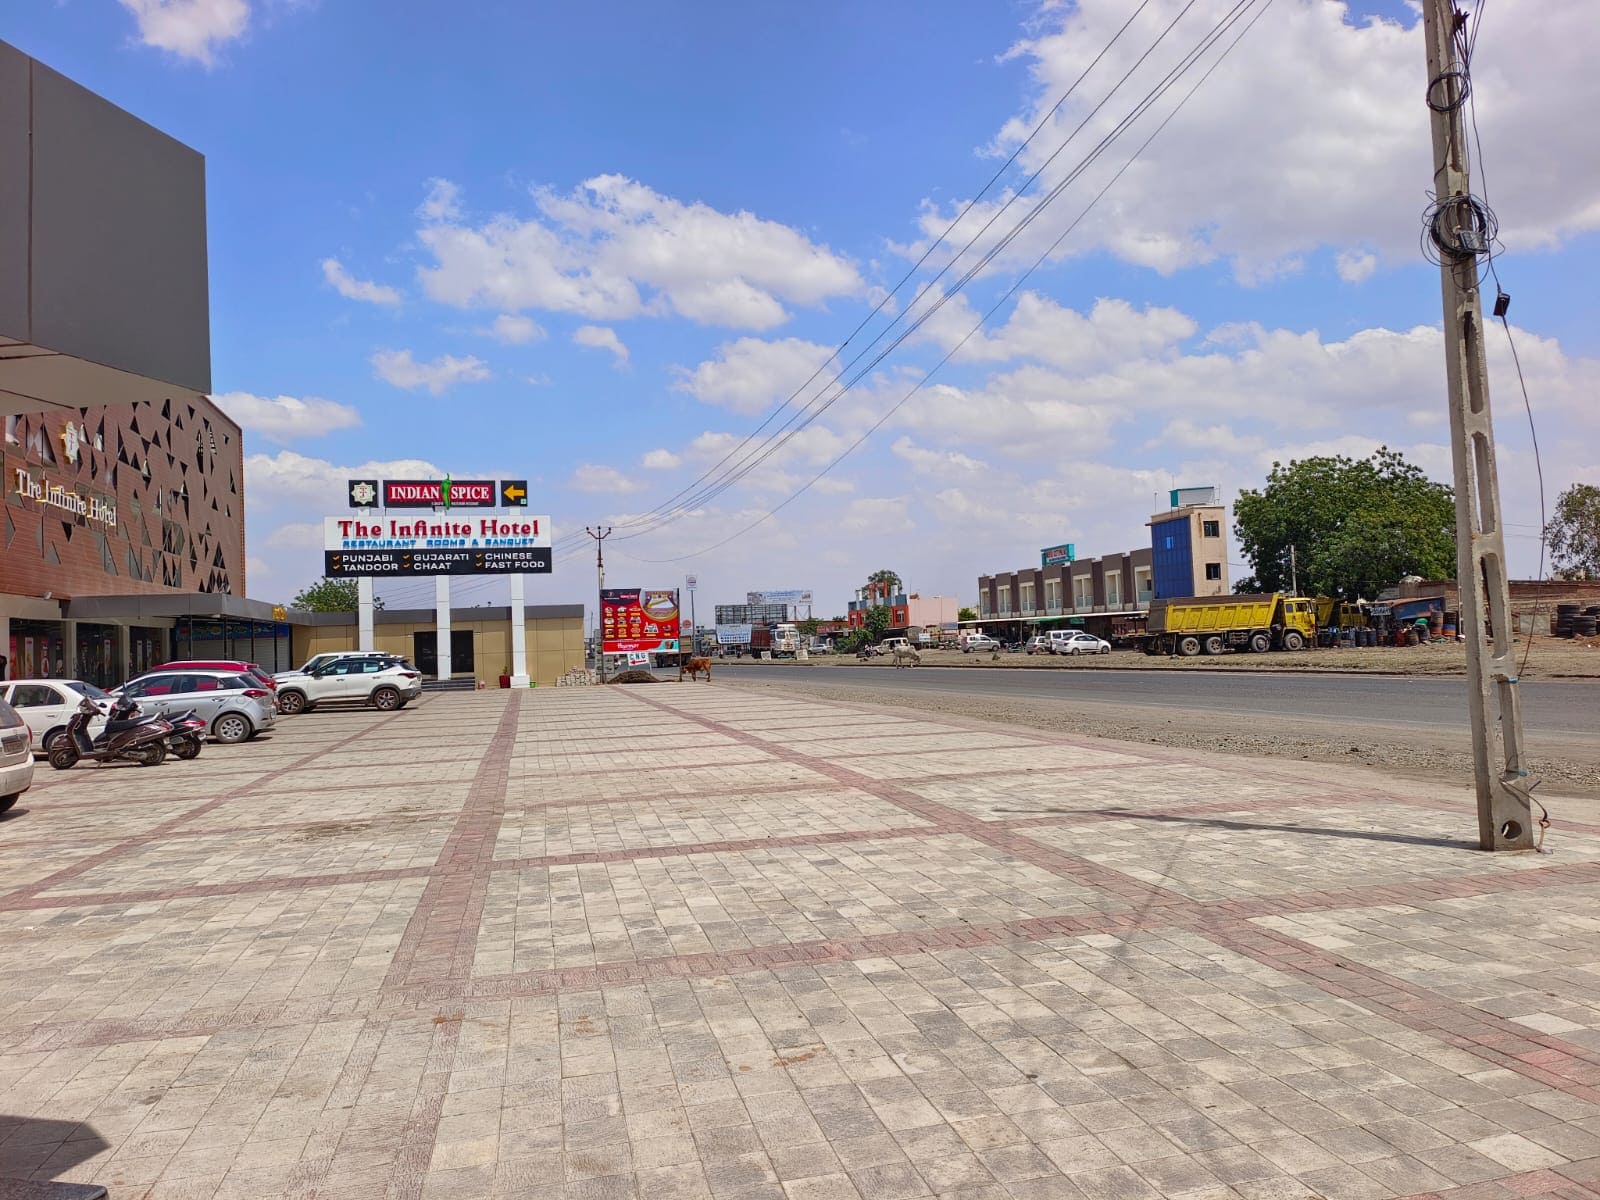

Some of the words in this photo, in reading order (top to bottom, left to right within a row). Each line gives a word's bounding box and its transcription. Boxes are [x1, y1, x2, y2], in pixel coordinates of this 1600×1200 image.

[391, 486, 440, 499] INDIAN
[451, 486, 489, 499] SPICE
[338, 520, 382, 538] The
[390, 519, 472, 538] Infinite
[480, 519, 539, 536] Hotel
[343, 539, 416, 549] RESTAURANT
[427, 538, 466, 547] ROOMS
[485, 538, 535, 546] BANQUET
[342, 554, 393, 562] PUNJABI
[413, 553, 469, 561] GUJARATI
[484, 552, 533, 560] CHINESE
[342, 563, 399, 571] TANDOOR
[413, 562, 452, 570] CHAAT
[484, 561, 512, 569] FAST
